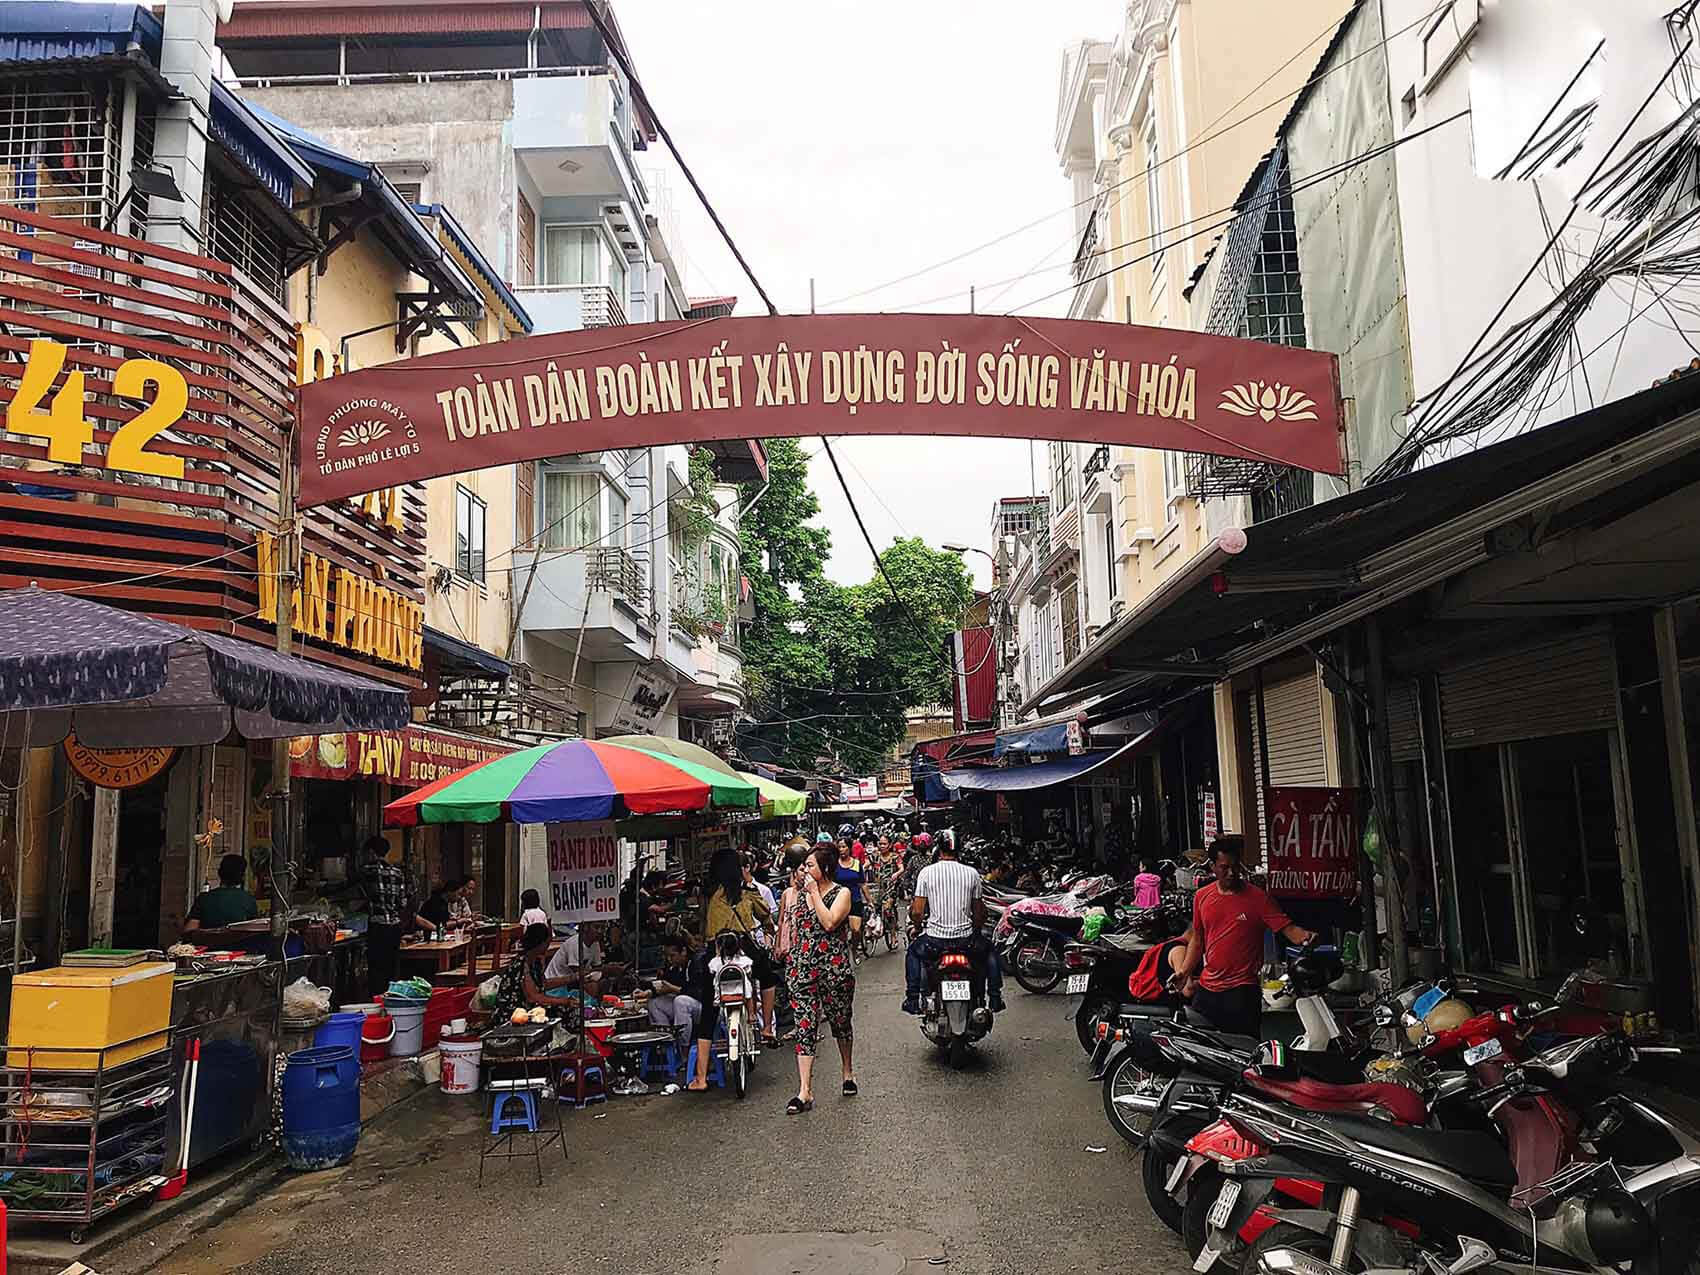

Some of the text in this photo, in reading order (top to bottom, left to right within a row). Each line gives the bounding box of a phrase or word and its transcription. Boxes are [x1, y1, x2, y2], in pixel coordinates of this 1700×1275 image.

[6, 339, 190, 480] 42
[436, 338, 1196, 441] TOÀN DÂN ĐOÀN KẾT XÂY DỰNG ĐỜI SỐNG VĂN HÓA
[317, 425, 331, 460] UBND
[328, 398, 378, 424] PHƯỜNG
[380, 400, 407, 421] MÁY
[334, 456, 356, 472] DÂN
[380, 447, 393, 461] LÊ
[394, 443, 411, 459] LỢI
[412, 442, 420, 453] 5
[551, 829, 587, 872] BÁNH
[1270, 801, 1300, 858] GÀ
[552, 875, 588, 912] BÁNH
[1348, 1161, 1437, 1197] AIR BLADE
